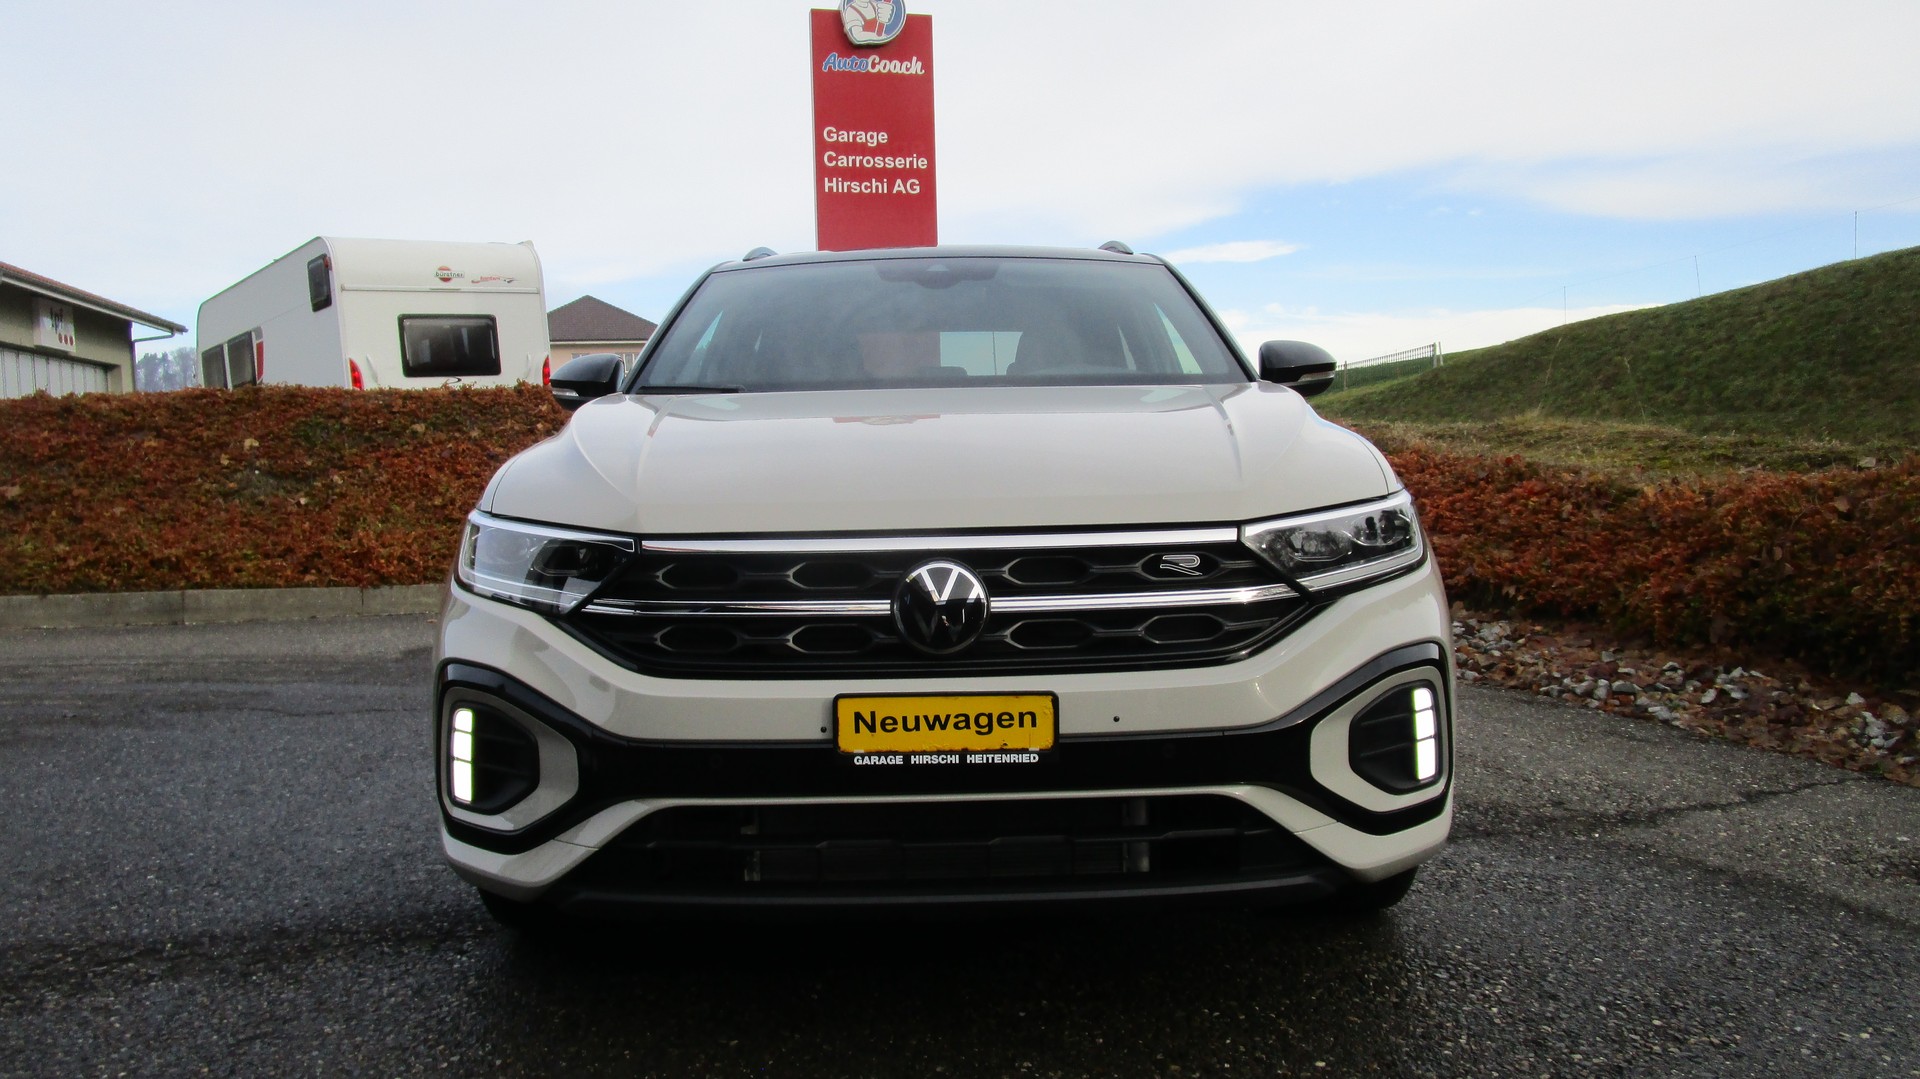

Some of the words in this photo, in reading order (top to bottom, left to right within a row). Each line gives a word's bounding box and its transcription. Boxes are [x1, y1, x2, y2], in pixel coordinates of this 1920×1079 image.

[822, 52, 925, 75] AutoCoach
[823, 126, 888, 147] Garage
[823, 151, 928, 169] Carrosserie
[824, 177, 888, 194] Hirschi
[892, 178, 921, 195] AG
[853, 709, 1038, 736] Neuwagen
[853, 755, 904, 765] GARAGE
[910, 754, 960, 765] HIRSCHI
[966, 753, 1039, 764] HEITENRIED
